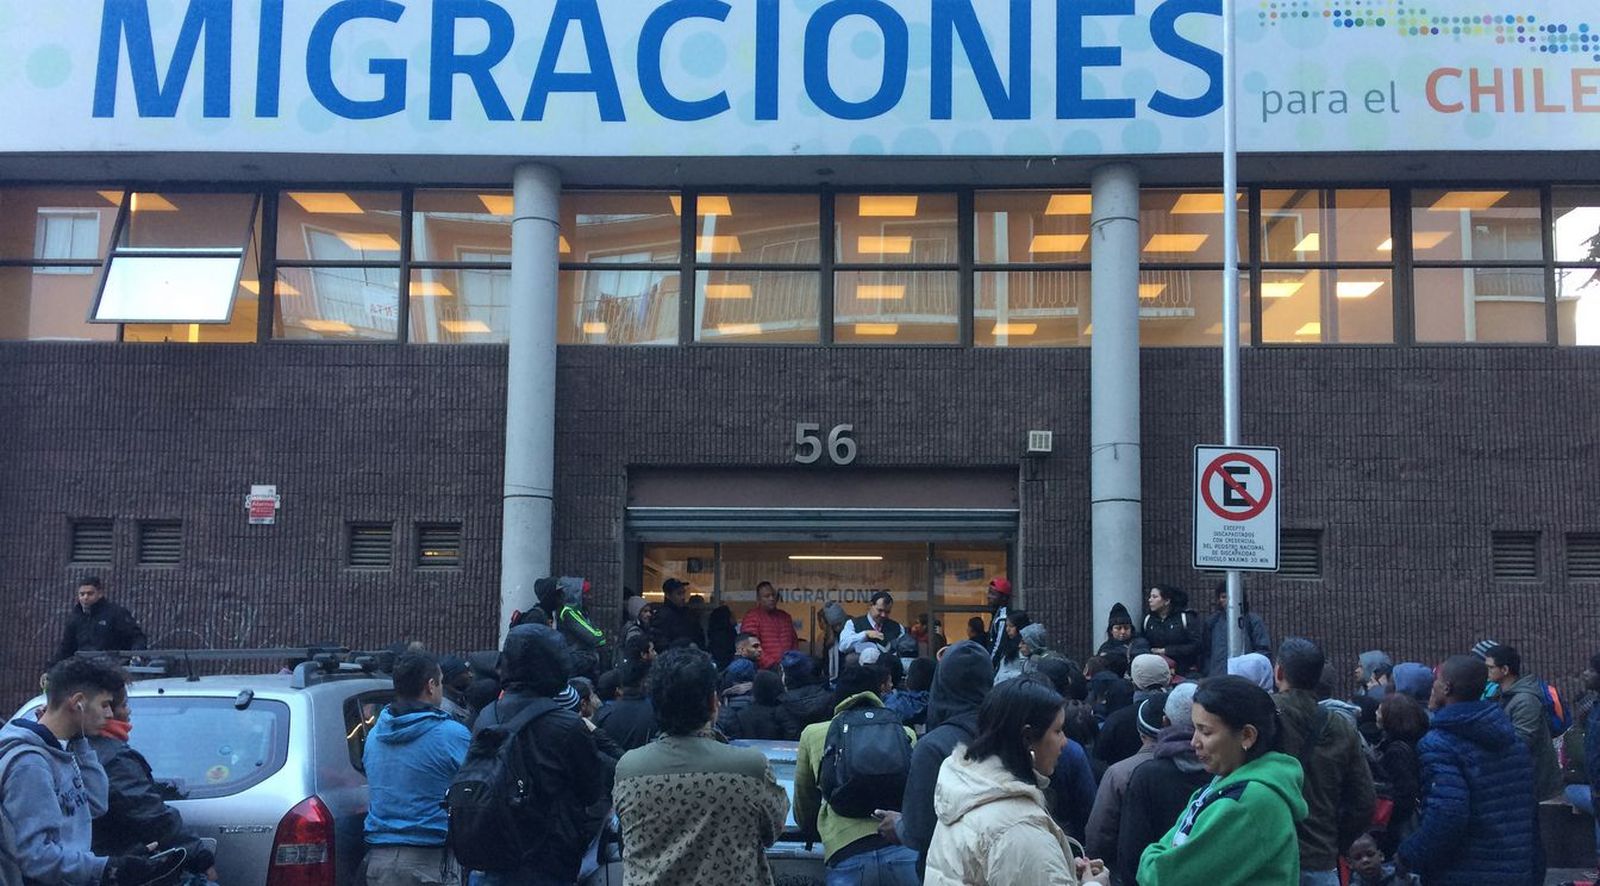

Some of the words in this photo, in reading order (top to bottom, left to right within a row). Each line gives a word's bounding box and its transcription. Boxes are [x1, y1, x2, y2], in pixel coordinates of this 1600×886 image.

[92, 0, 1223, 122] MIGRACIONES
[1261, 89, 1348, 122] para
[1364, 81, 1400, 114] el
[1425, 67, 1600, 114] CHILE
[794, 423, 857, 466] 56
[776, 588, 891, 603] MIGRACION
